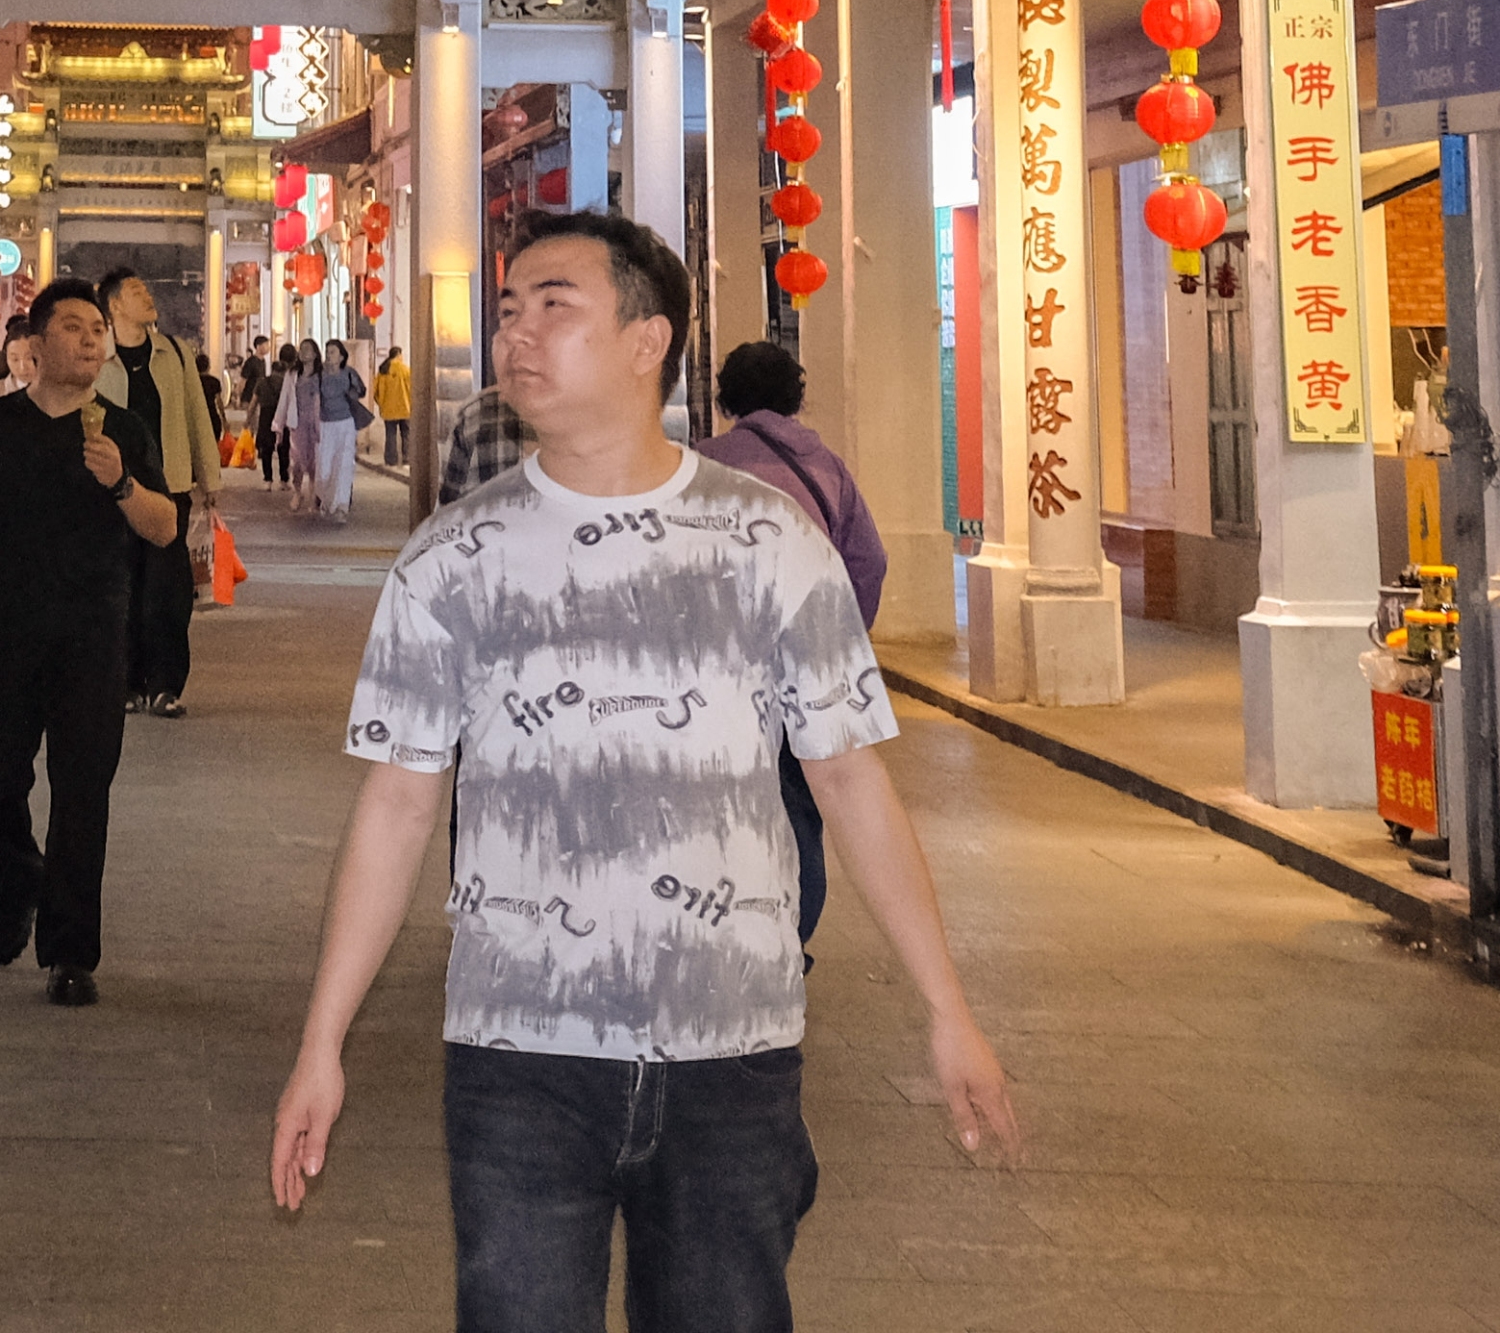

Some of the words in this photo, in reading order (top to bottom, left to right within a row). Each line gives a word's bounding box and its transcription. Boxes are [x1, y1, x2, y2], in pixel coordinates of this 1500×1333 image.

[1284, 15, 1334, 40] 正宗
[1283, 60, 1350, 412] 佛手老香黄
